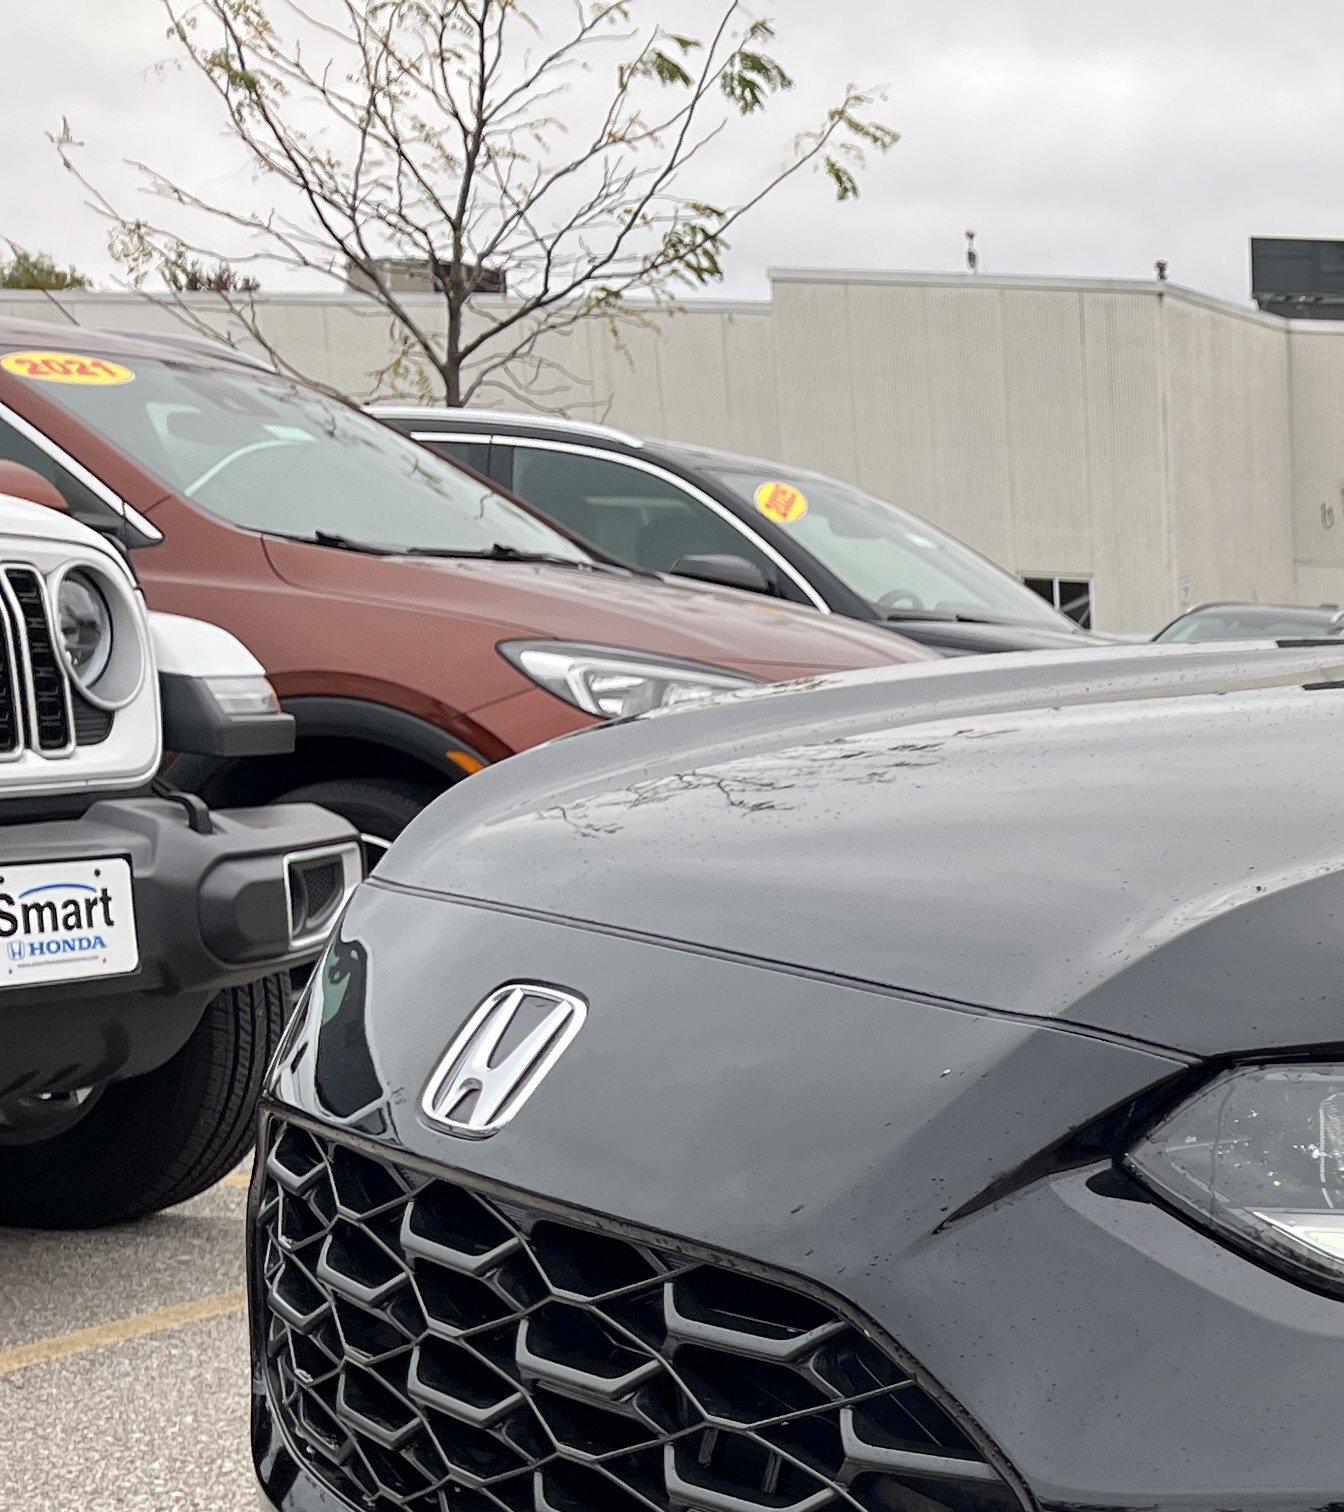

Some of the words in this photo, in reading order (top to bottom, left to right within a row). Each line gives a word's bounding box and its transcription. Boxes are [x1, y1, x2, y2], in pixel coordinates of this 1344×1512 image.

[15, 358, 117, 378] 2021
[0, 887, 114, 937] Smart
[29, 935, 107, 957] HONDA
